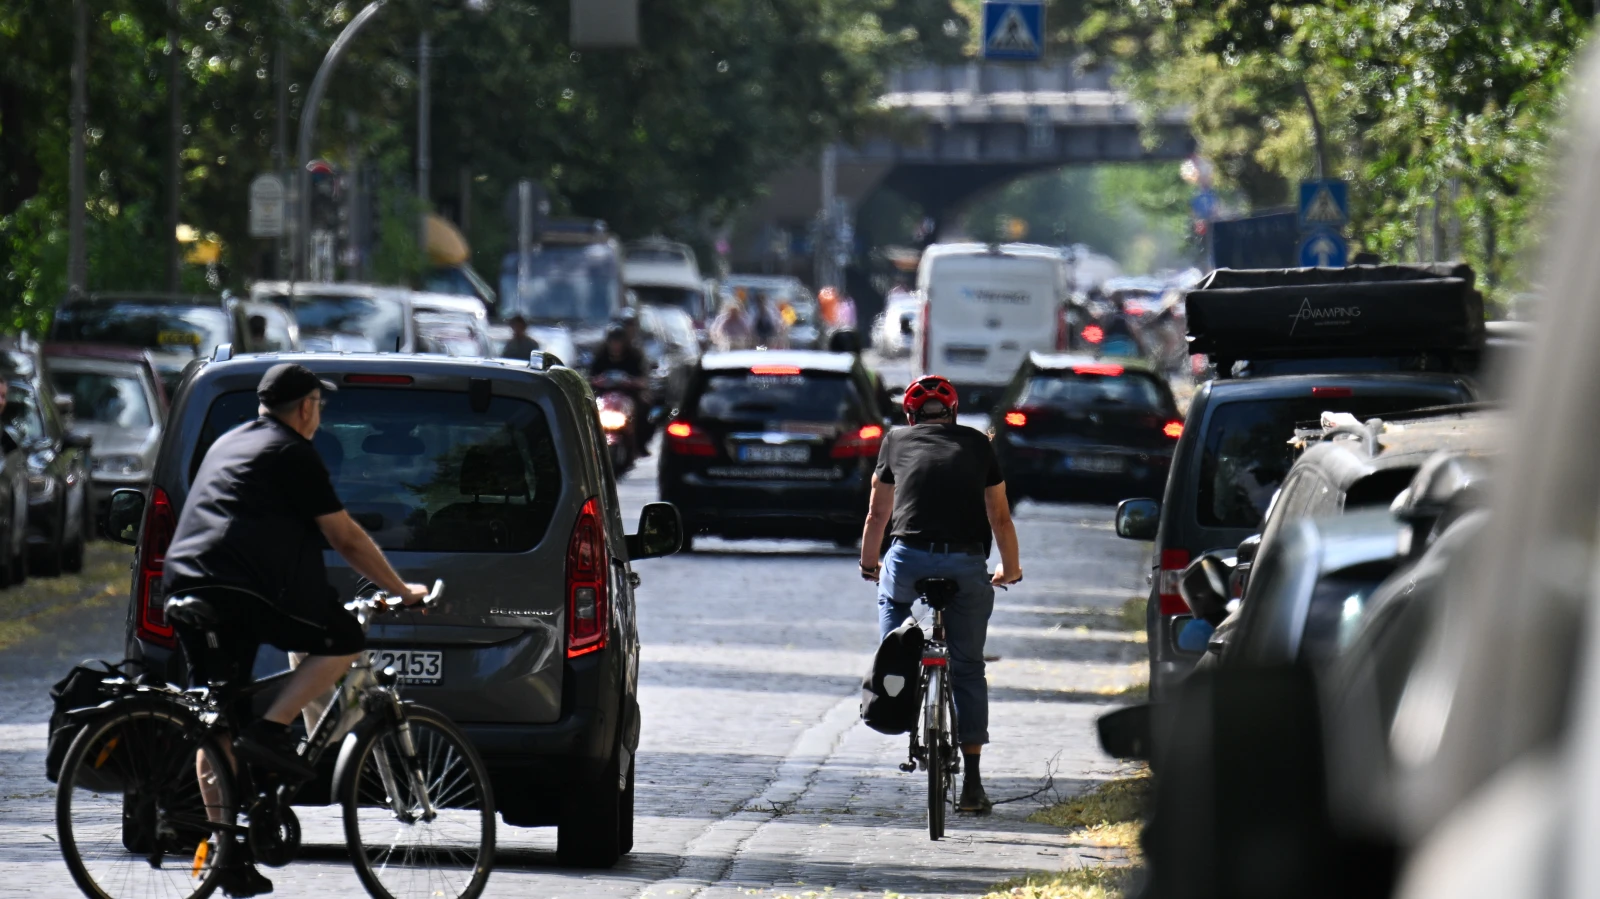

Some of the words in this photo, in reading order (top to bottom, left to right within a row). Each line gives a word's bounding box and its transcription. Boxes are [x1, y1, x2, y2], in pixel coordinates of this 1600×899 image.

[1288, 297, 1362, 336] ADVAMPING
[489, 607, 554, 616] BERLINGO
[381, 652, 440, 676] 2153
